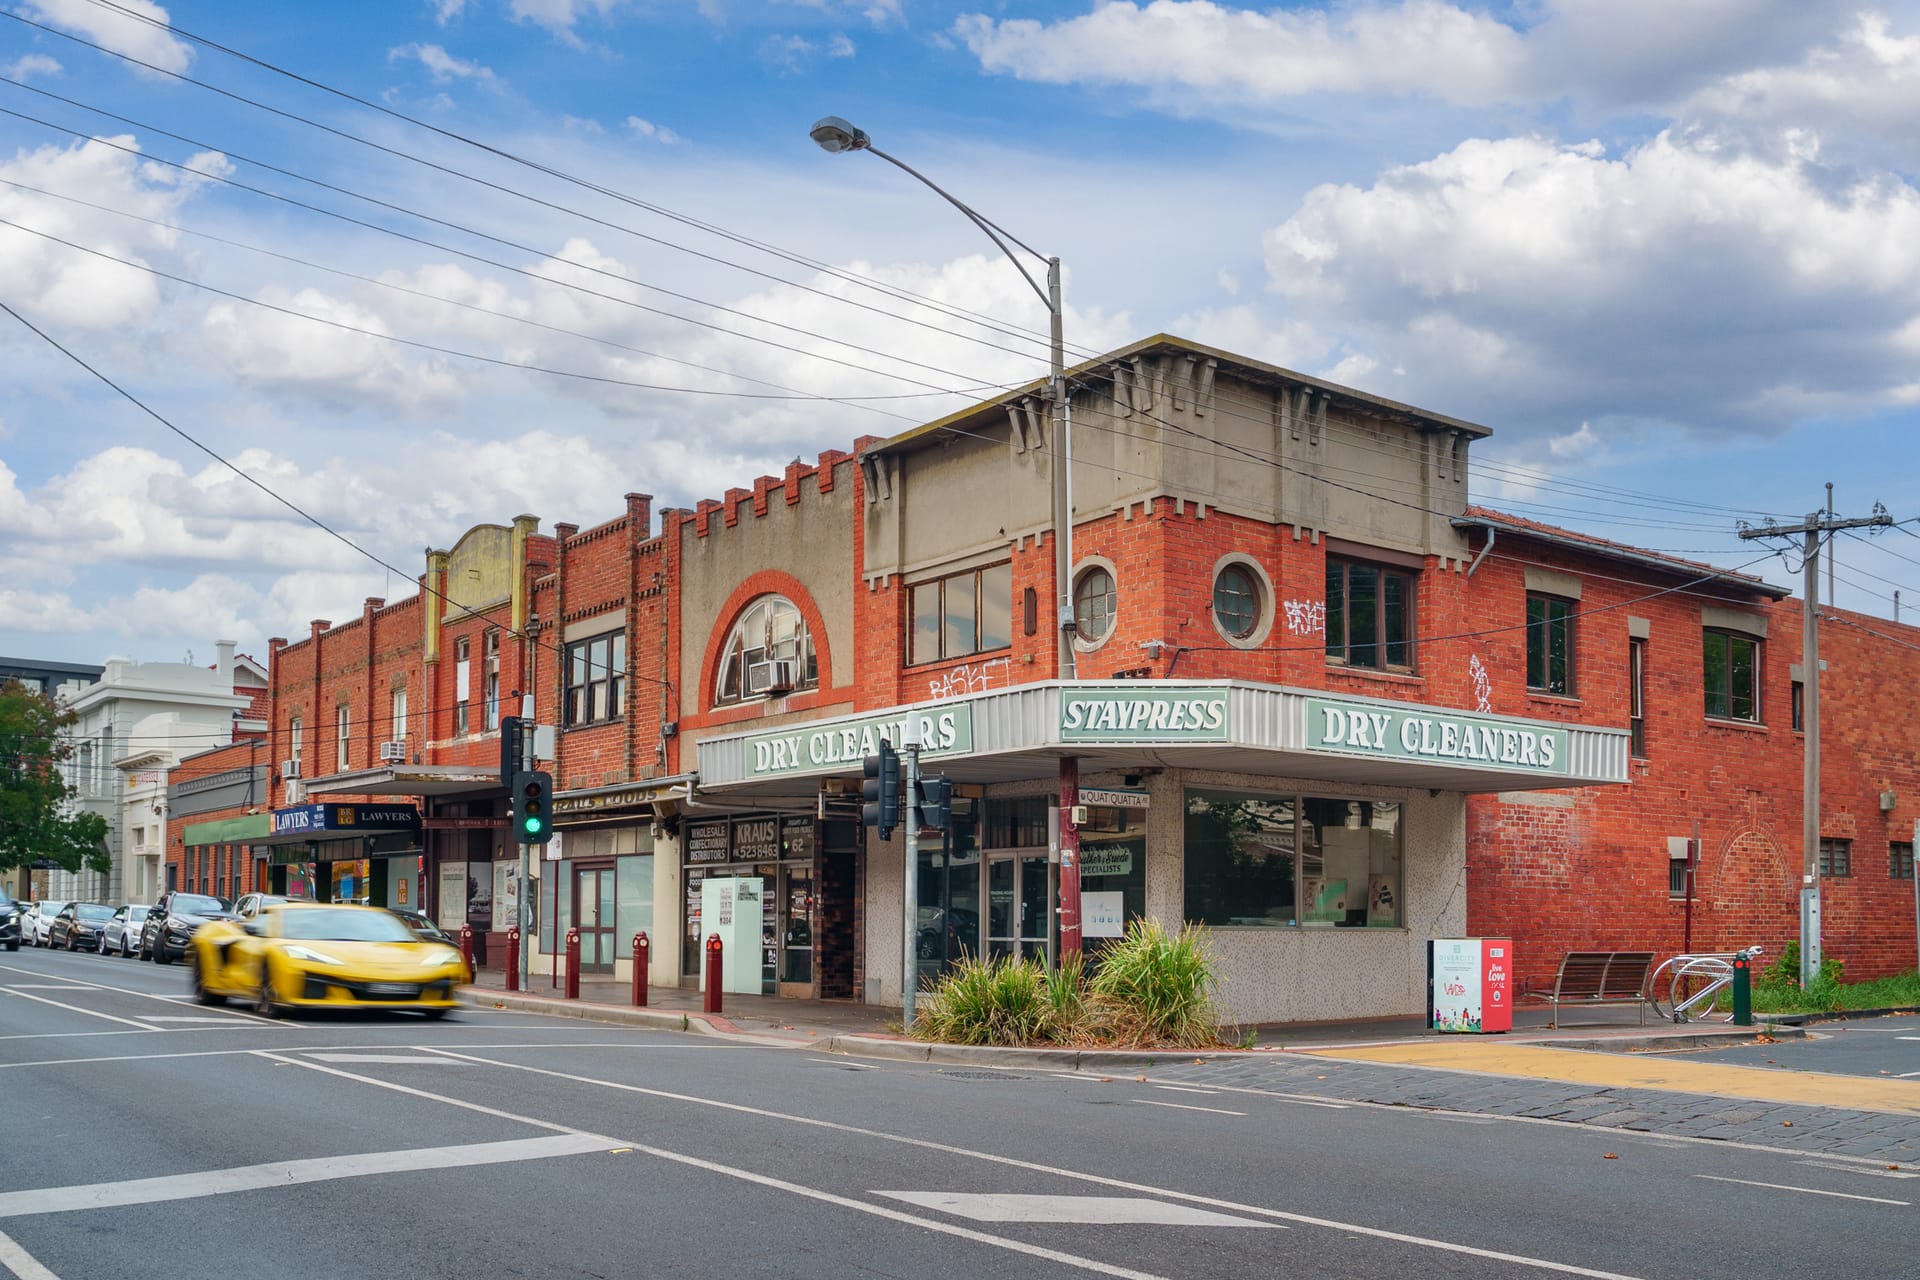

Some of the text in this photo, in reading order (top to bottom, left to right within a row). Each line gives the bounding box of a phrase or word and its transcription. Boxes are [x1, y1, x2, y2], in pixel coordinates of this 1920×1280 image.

[1063, 700, 1226, 731] STAYPRESS
[1322, 707, 1556, 768] DRY CLEANERS
[755, 736, 802, 772] DRY
[1086, 791, 1109, 802] QUAT
[1111, 793, 1141, 805] QUATTA
[276, 811, 309, 830] LAWYERS
[361, 812, 412, 821] LAWYERS
[691, 825, 725, 838] WHOLESALE
[737, 821, 775, 843] KRAUS
[740, 844, 778, 859] 5238463
[791, 838, 804, 852] 62
[690, 849, 725, 861] DISTRIBUTORS
